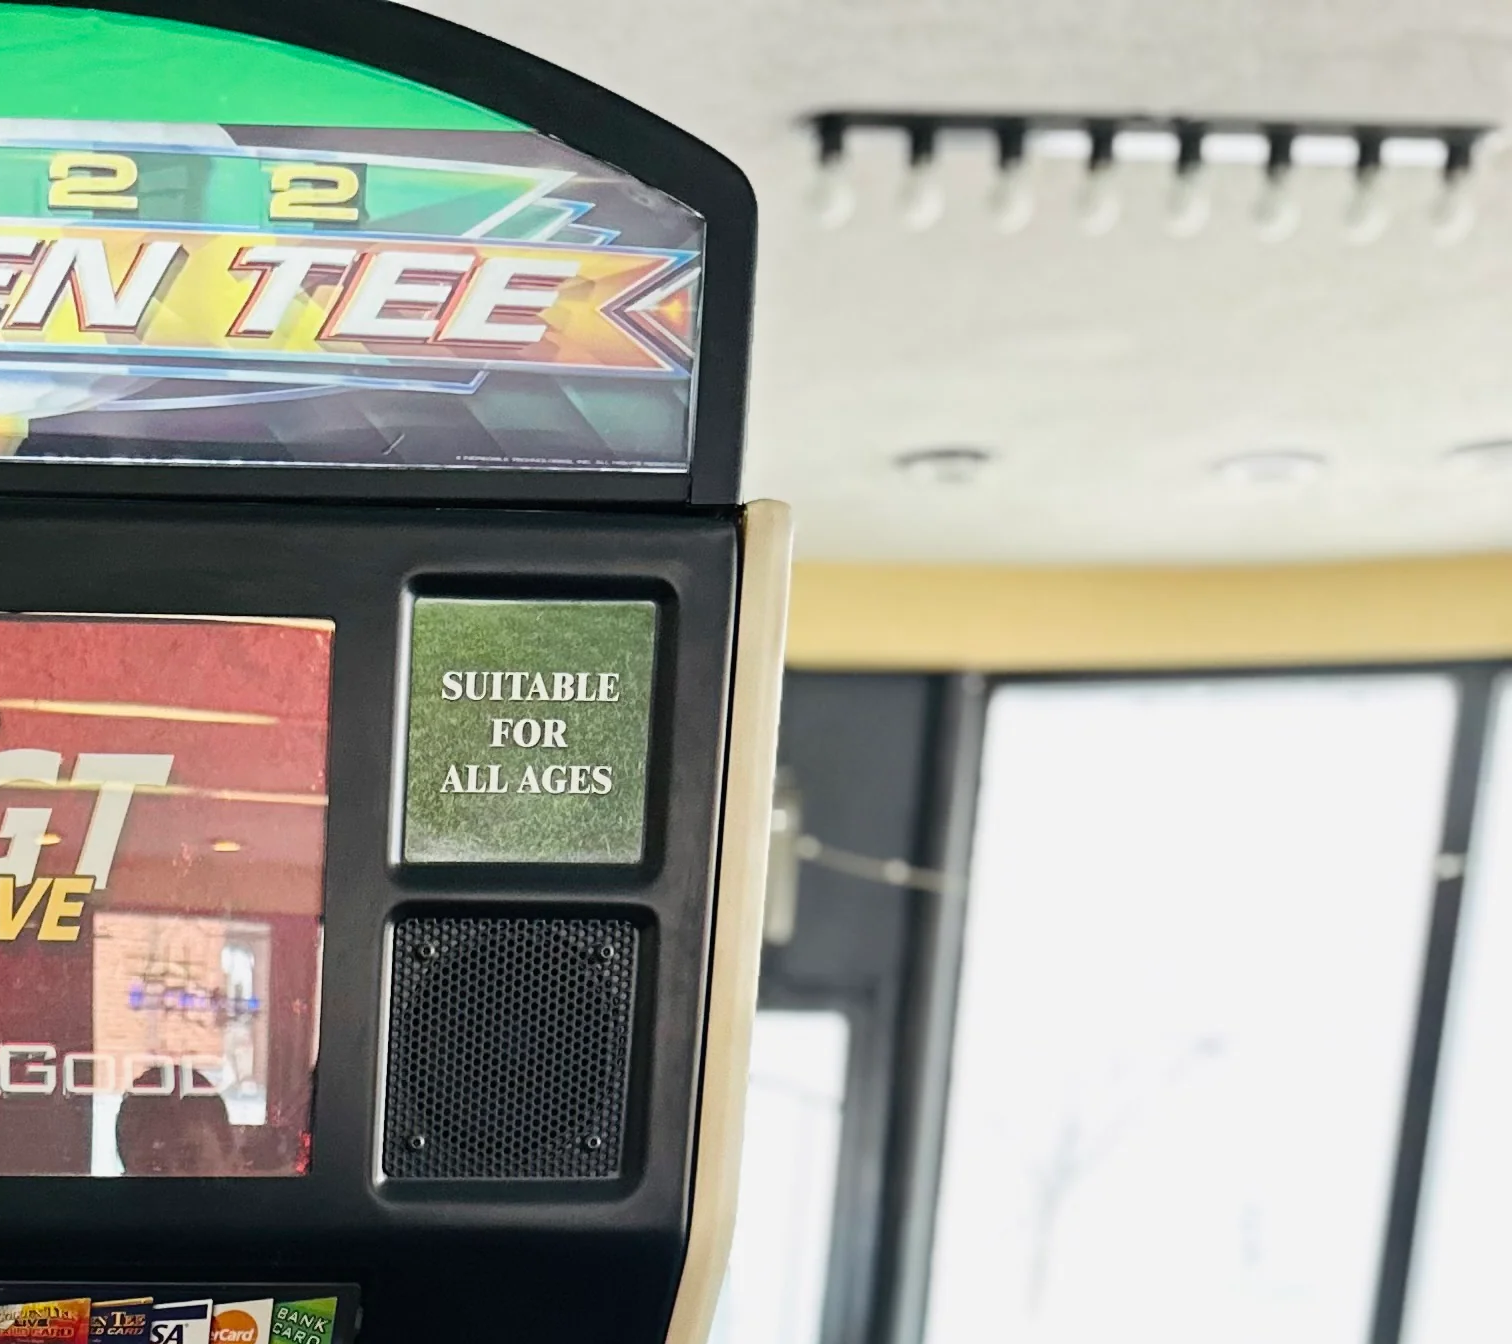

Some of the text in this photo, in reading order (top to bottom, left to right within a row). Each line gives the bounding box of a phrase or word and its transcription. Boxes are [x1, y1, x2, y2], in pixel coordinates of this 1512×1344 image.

[229, 243, 583, 347] TEE
[441, 671, 620, 702] SUITABLE
[489, 718, 568, 748] FOR
[440, 764, 612, 795] ALL AGES
[277, 1307, 327, 1334] BANK
